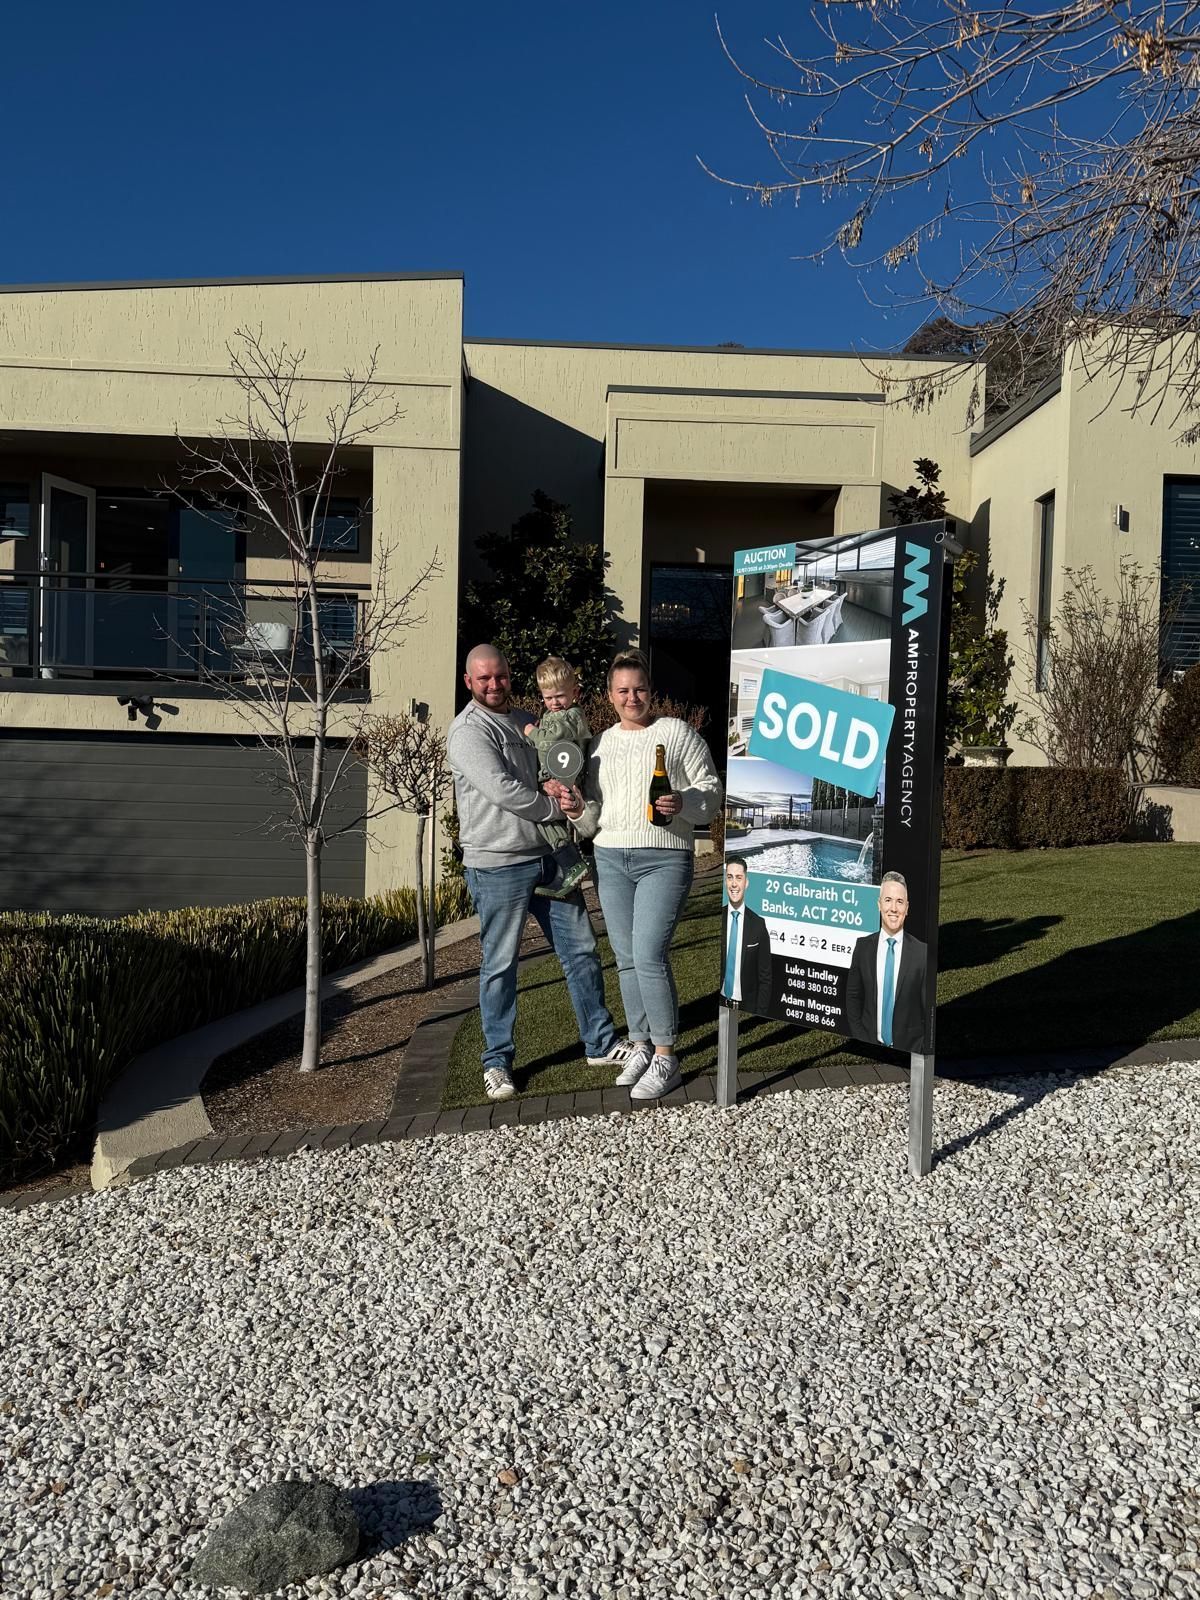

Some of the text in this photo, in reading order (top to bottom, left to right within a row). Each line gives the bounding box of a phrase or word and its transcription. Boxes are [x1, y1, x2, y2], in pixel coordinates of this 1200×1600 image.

[743, 548, 786, 564] AUCTION
[758, 691, 879, 770] SOLD
[900, 628, 919, 828] AMPROPERTYAGENCY
[557, 751, 570, 769] 9
[766, 879, 859, 906] 29 Galbraith Cl,
[761, 899, 863, 926] Banks, ACT 2906
[779, 932, 786, 943] 4
[799, 935, 806, 946] 2
[820, 939, 828, 950] 2
[831, 944, 846, 954] EER
[785, 963, 839, 985] Luke Lindley
[787, 978, 837, 996] 0488 380 033
[780, 993, 842, 1015] Adam Morgan
[785, 1008, 836, 1027] 0487 888 666
